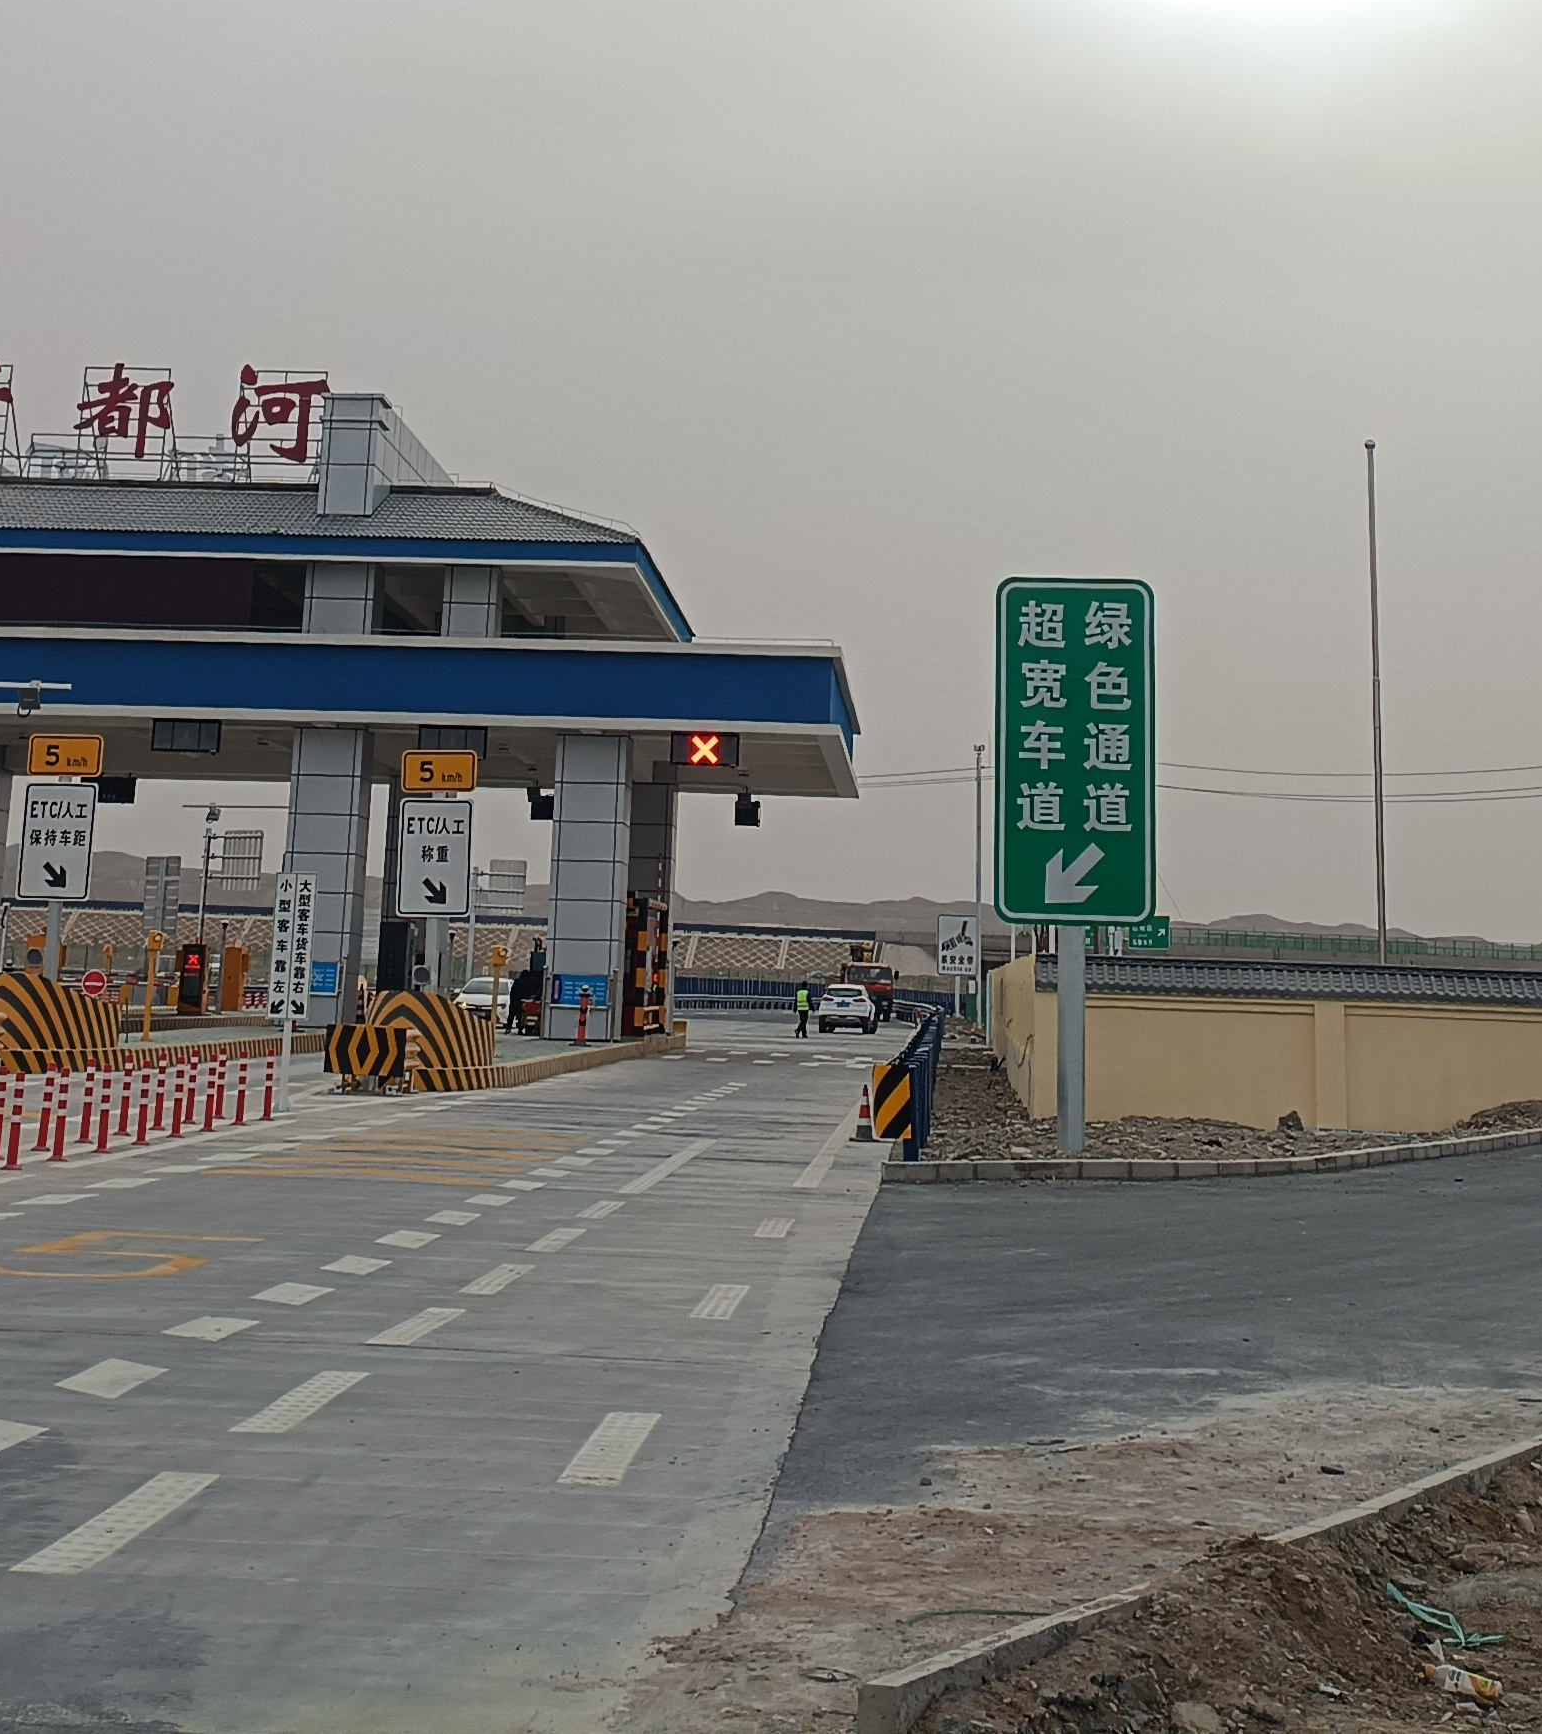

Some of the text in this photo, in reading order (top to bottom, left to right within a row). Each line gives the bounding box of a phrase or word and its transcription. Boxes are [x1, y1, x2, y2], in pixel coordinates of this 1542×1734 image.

[1017, 601, 1067, 831] 超宽车道
[1083, 601, 1133, 832] 绿色通道
[45, 745, 88, 767] 5 km/h
[420, 761, 462, 782] 5 km/h
[30, 801, 88, 819] ETC/人工
[407, 817, 465, 835] ETC/人工
[29, 829, 87, 846] 保持车距
[421, 845, 449, 863] 称重
[273, 879, 292, 993] 小型客车靠左
[292, 879, 312, 994] 大型客车货车靠右
